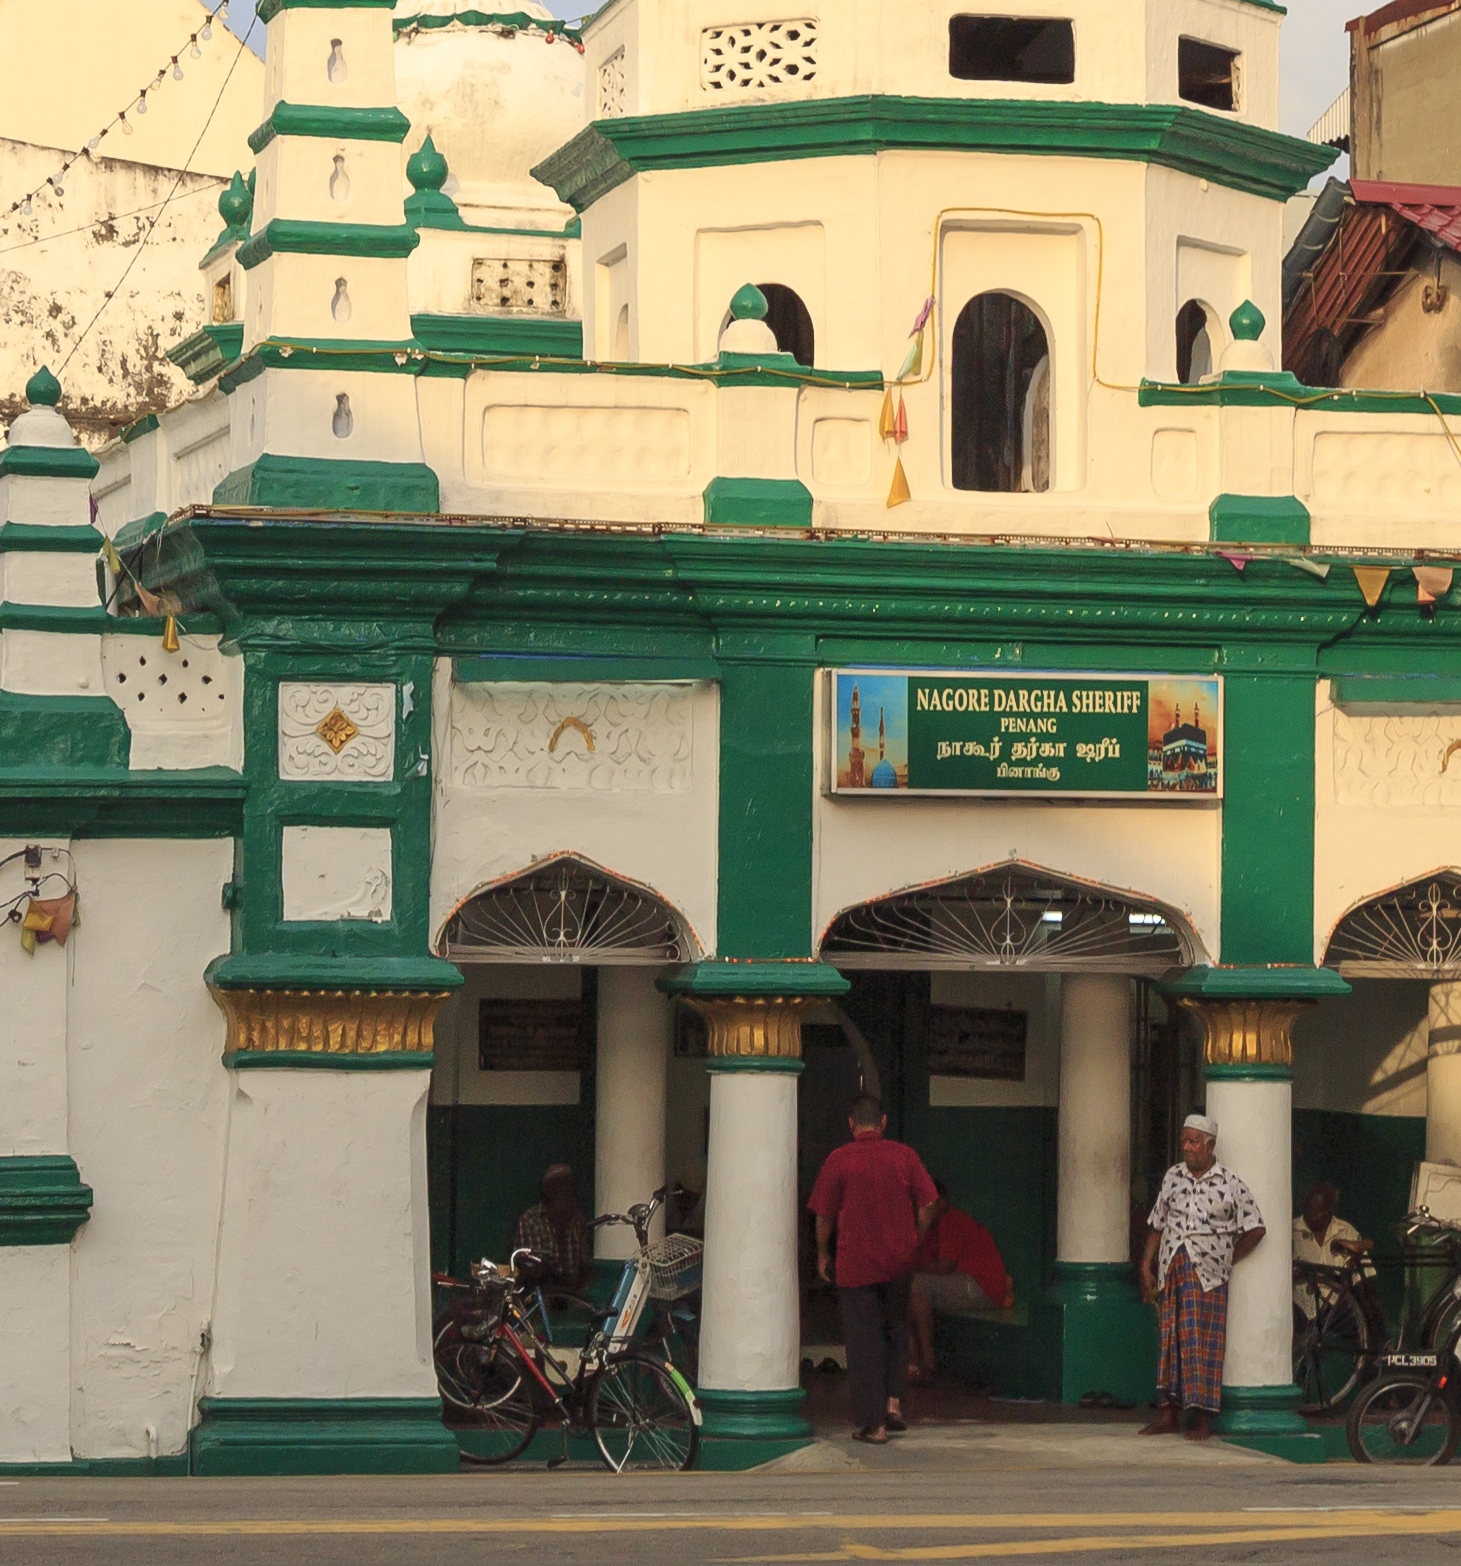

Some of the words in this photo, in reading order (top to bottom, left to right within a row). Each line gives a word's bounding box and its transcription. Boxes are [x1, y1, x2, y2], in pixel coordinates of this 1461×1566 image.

[917, 689, 989, 711] NAGORE
[993, 690, 1068, 713] DARGHA
[1072, 690, 1141, 713] SHERIFF
[1000, 718, 1057, 733] PENANG
[1387, 1355, 1408, 1366] PCL
